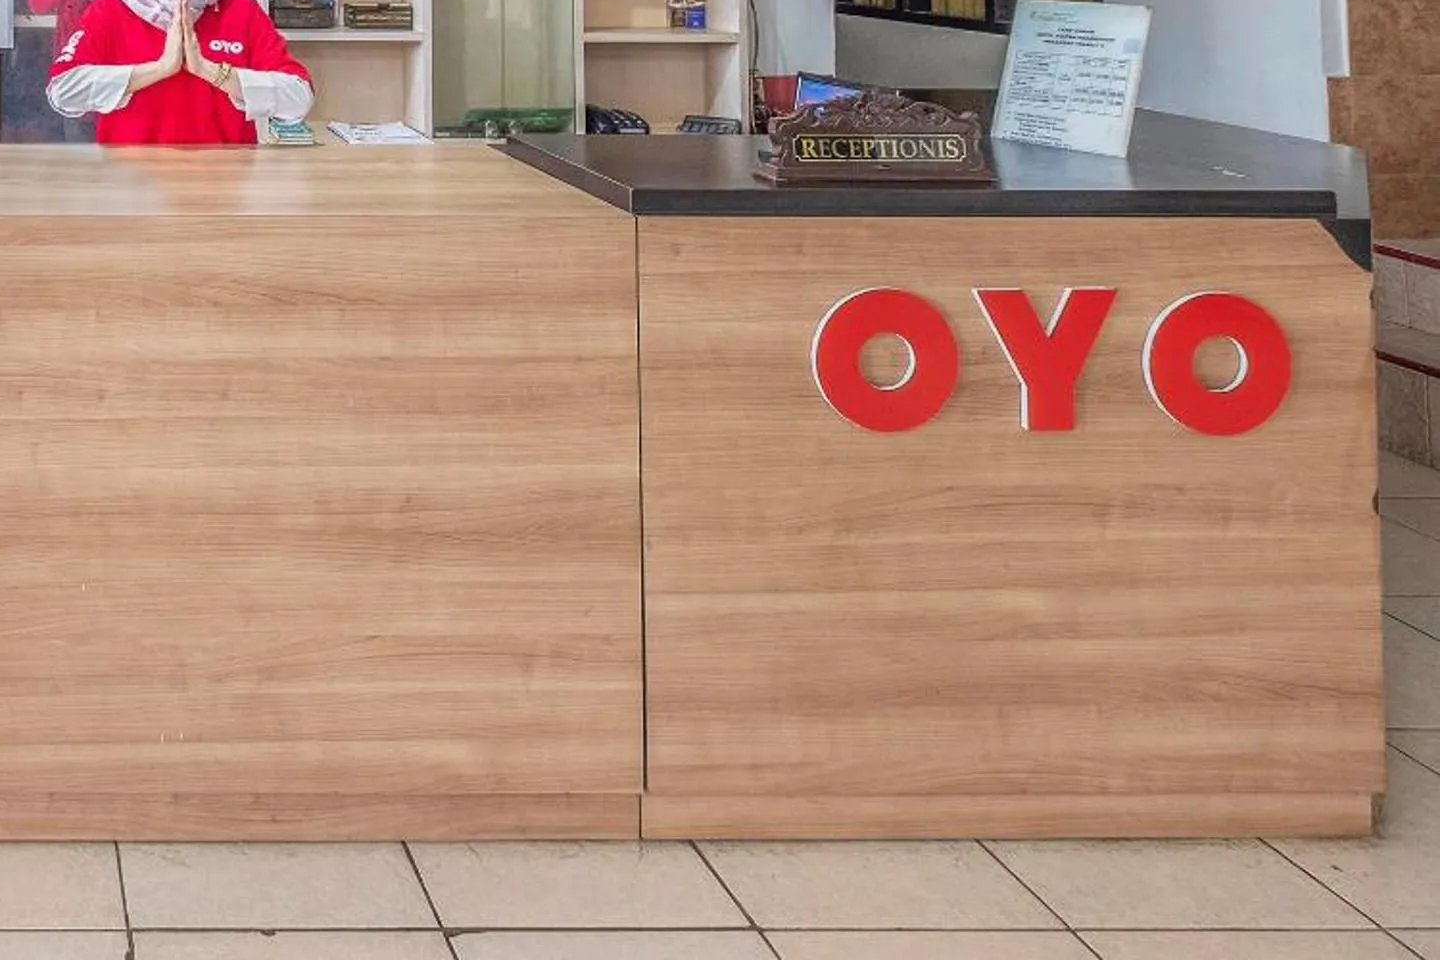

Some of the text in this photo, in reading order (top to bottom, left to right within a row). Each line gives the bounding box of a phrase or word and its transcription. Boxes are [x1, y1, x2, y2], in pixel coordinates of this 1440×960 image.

[208, 39, 245, 55] OYO
[800, 139, 960, 158] RECEPTIONIS
[811, 286, 1292, 436] OYO
